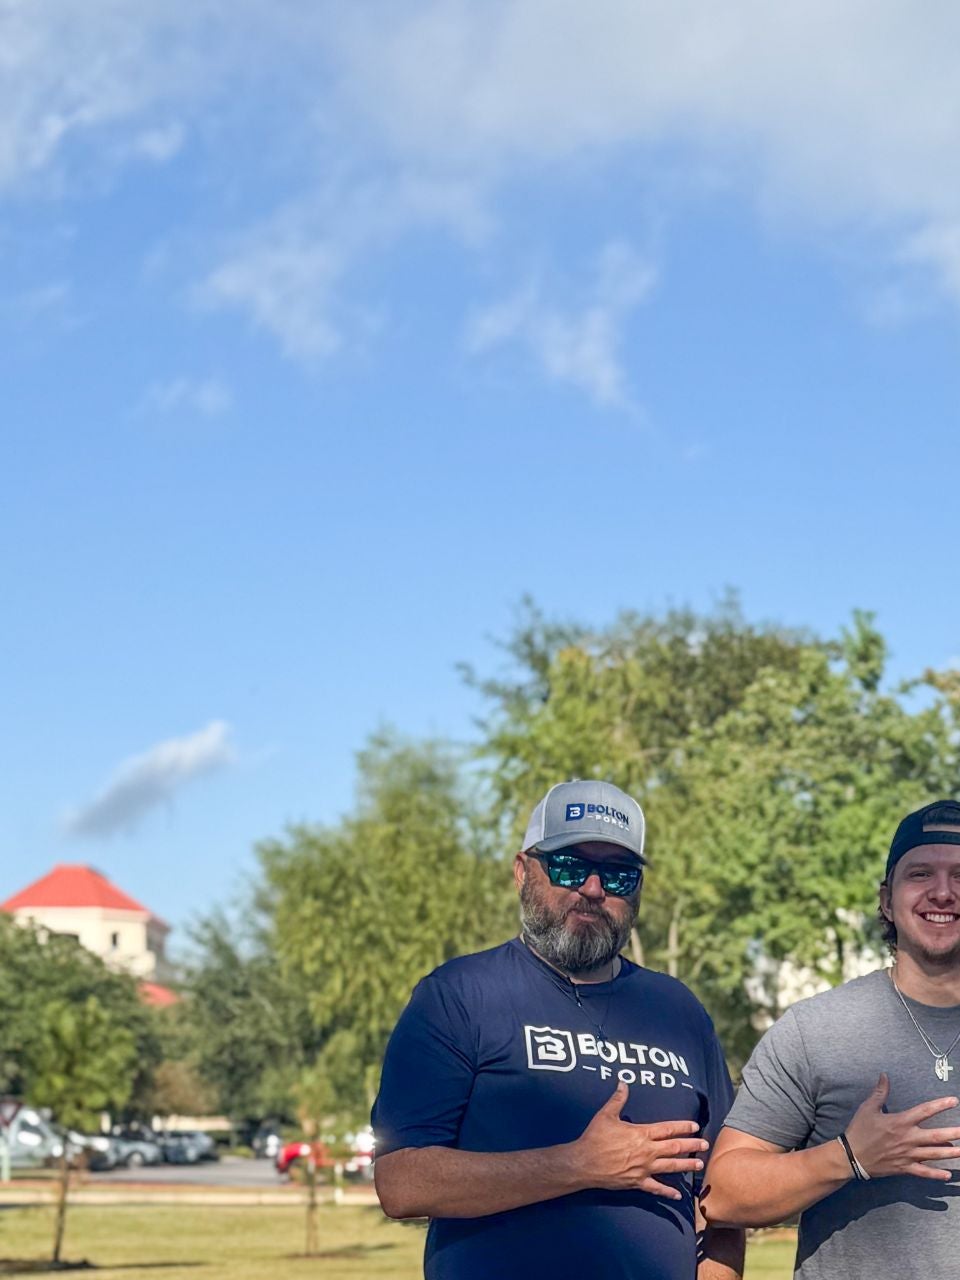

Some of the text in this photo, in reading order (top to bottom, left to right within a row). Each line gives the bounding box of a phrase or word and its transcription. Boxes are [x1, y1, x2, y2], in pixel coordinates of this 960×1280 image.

[587, 803, 629, 825] BOLTON
[577, 1033, 690, 1077] BOLTON
[601, 1065, 676, 1088] FORD
